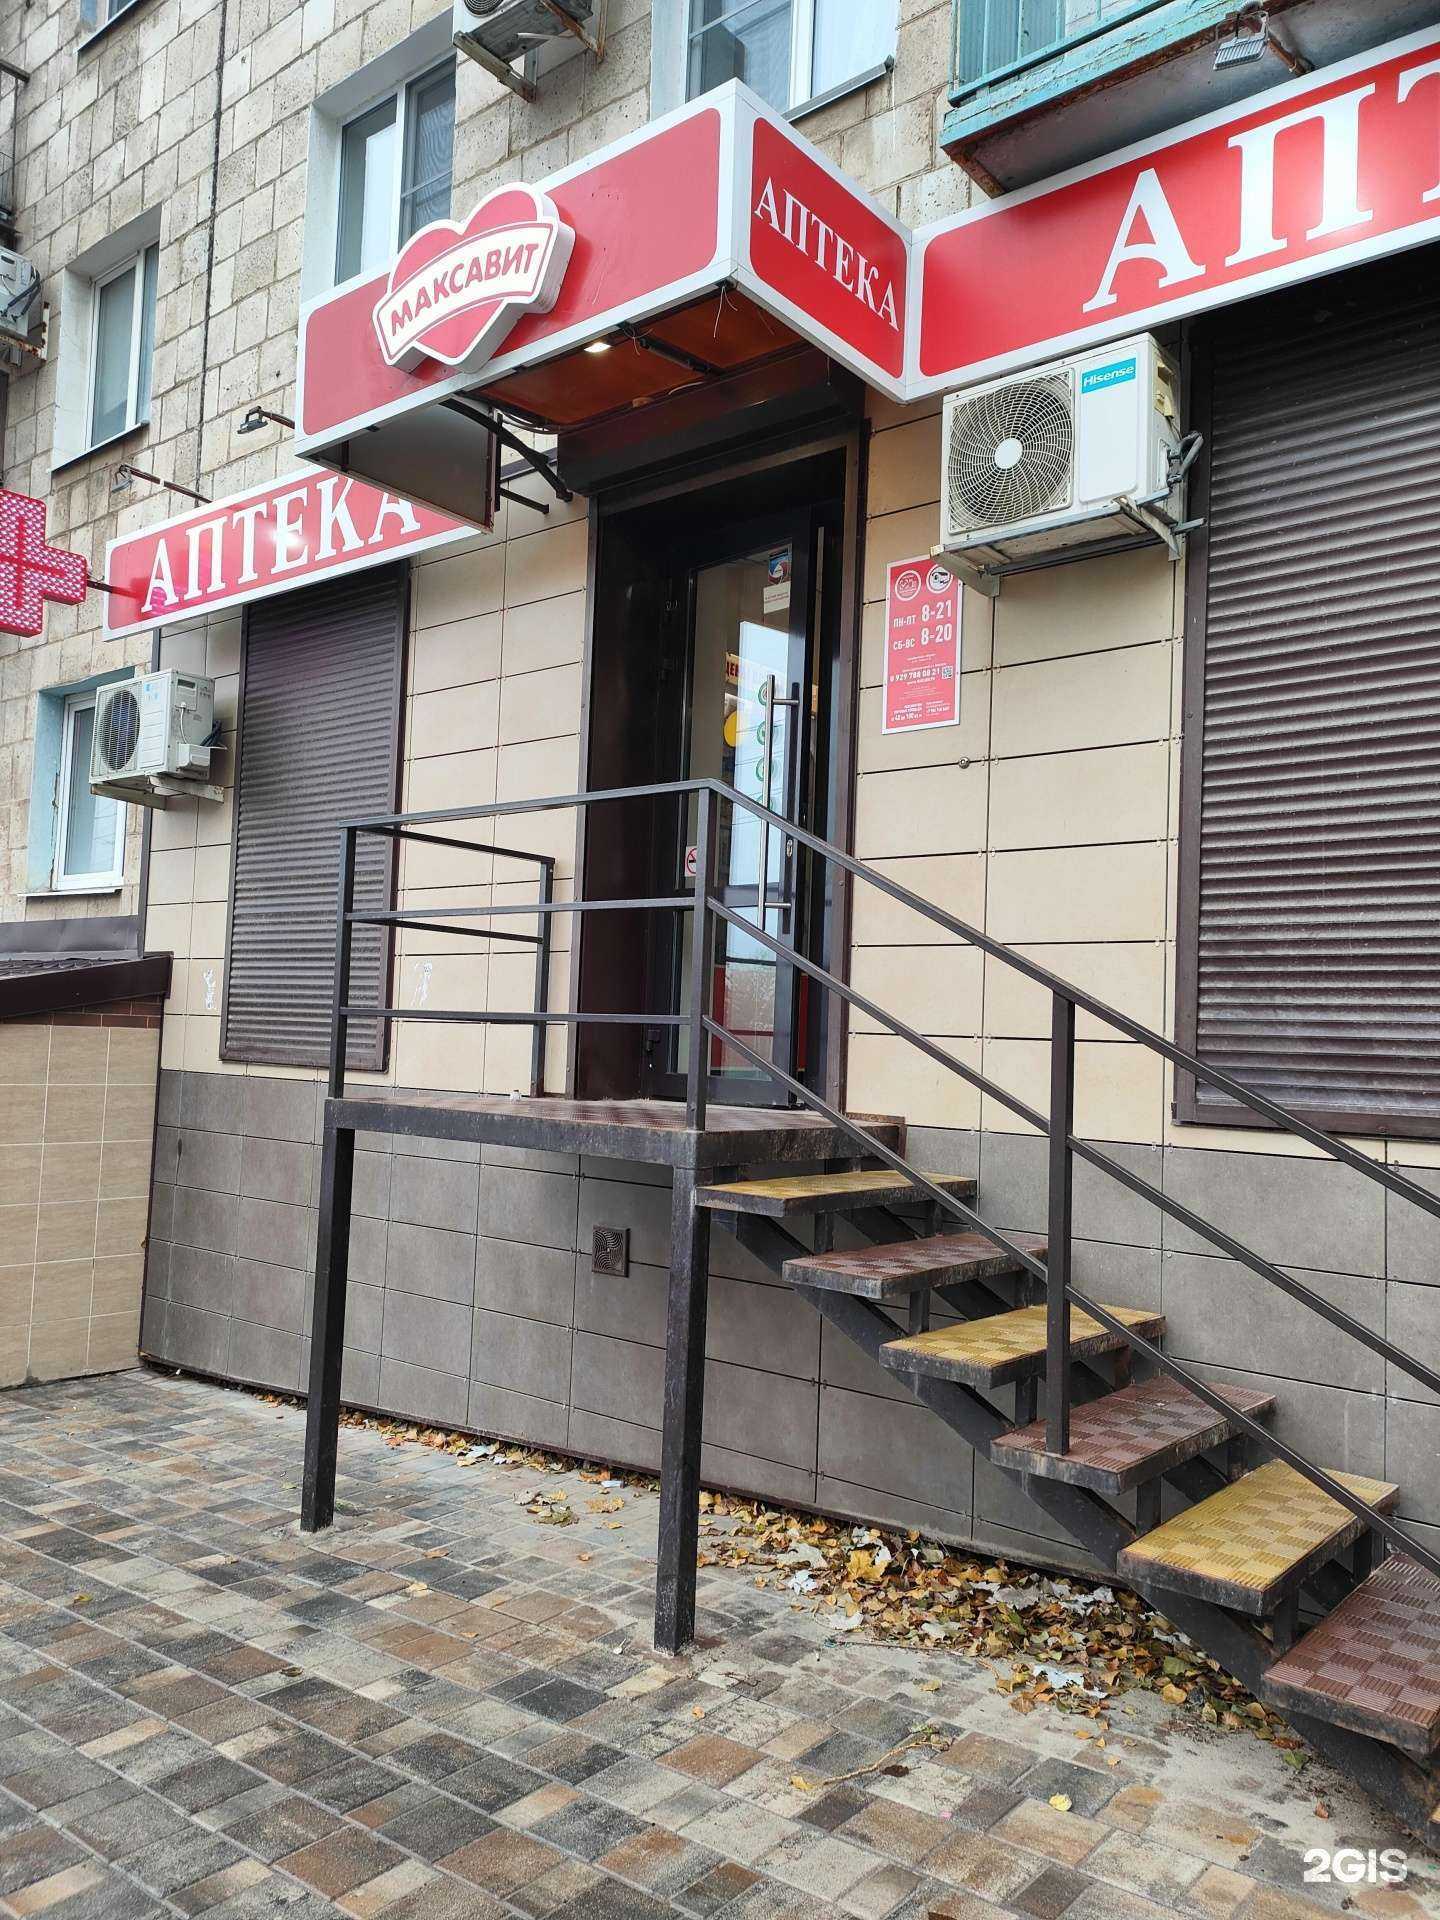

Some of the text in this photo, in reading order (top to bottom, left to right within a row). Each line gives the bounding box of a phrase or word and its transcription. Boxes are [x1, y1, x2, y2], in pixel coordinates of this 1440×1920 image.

[754, 176, 900, 333] АПТЕКА
[390, 243, 540, 337] МАКСАВИТ
[1083, 365, 1135, 387] Hisense
[893, 600, 952, 628] ПН-ПТ 8-21
[893, 624, 952, 650] СБ-ВС 8-20
